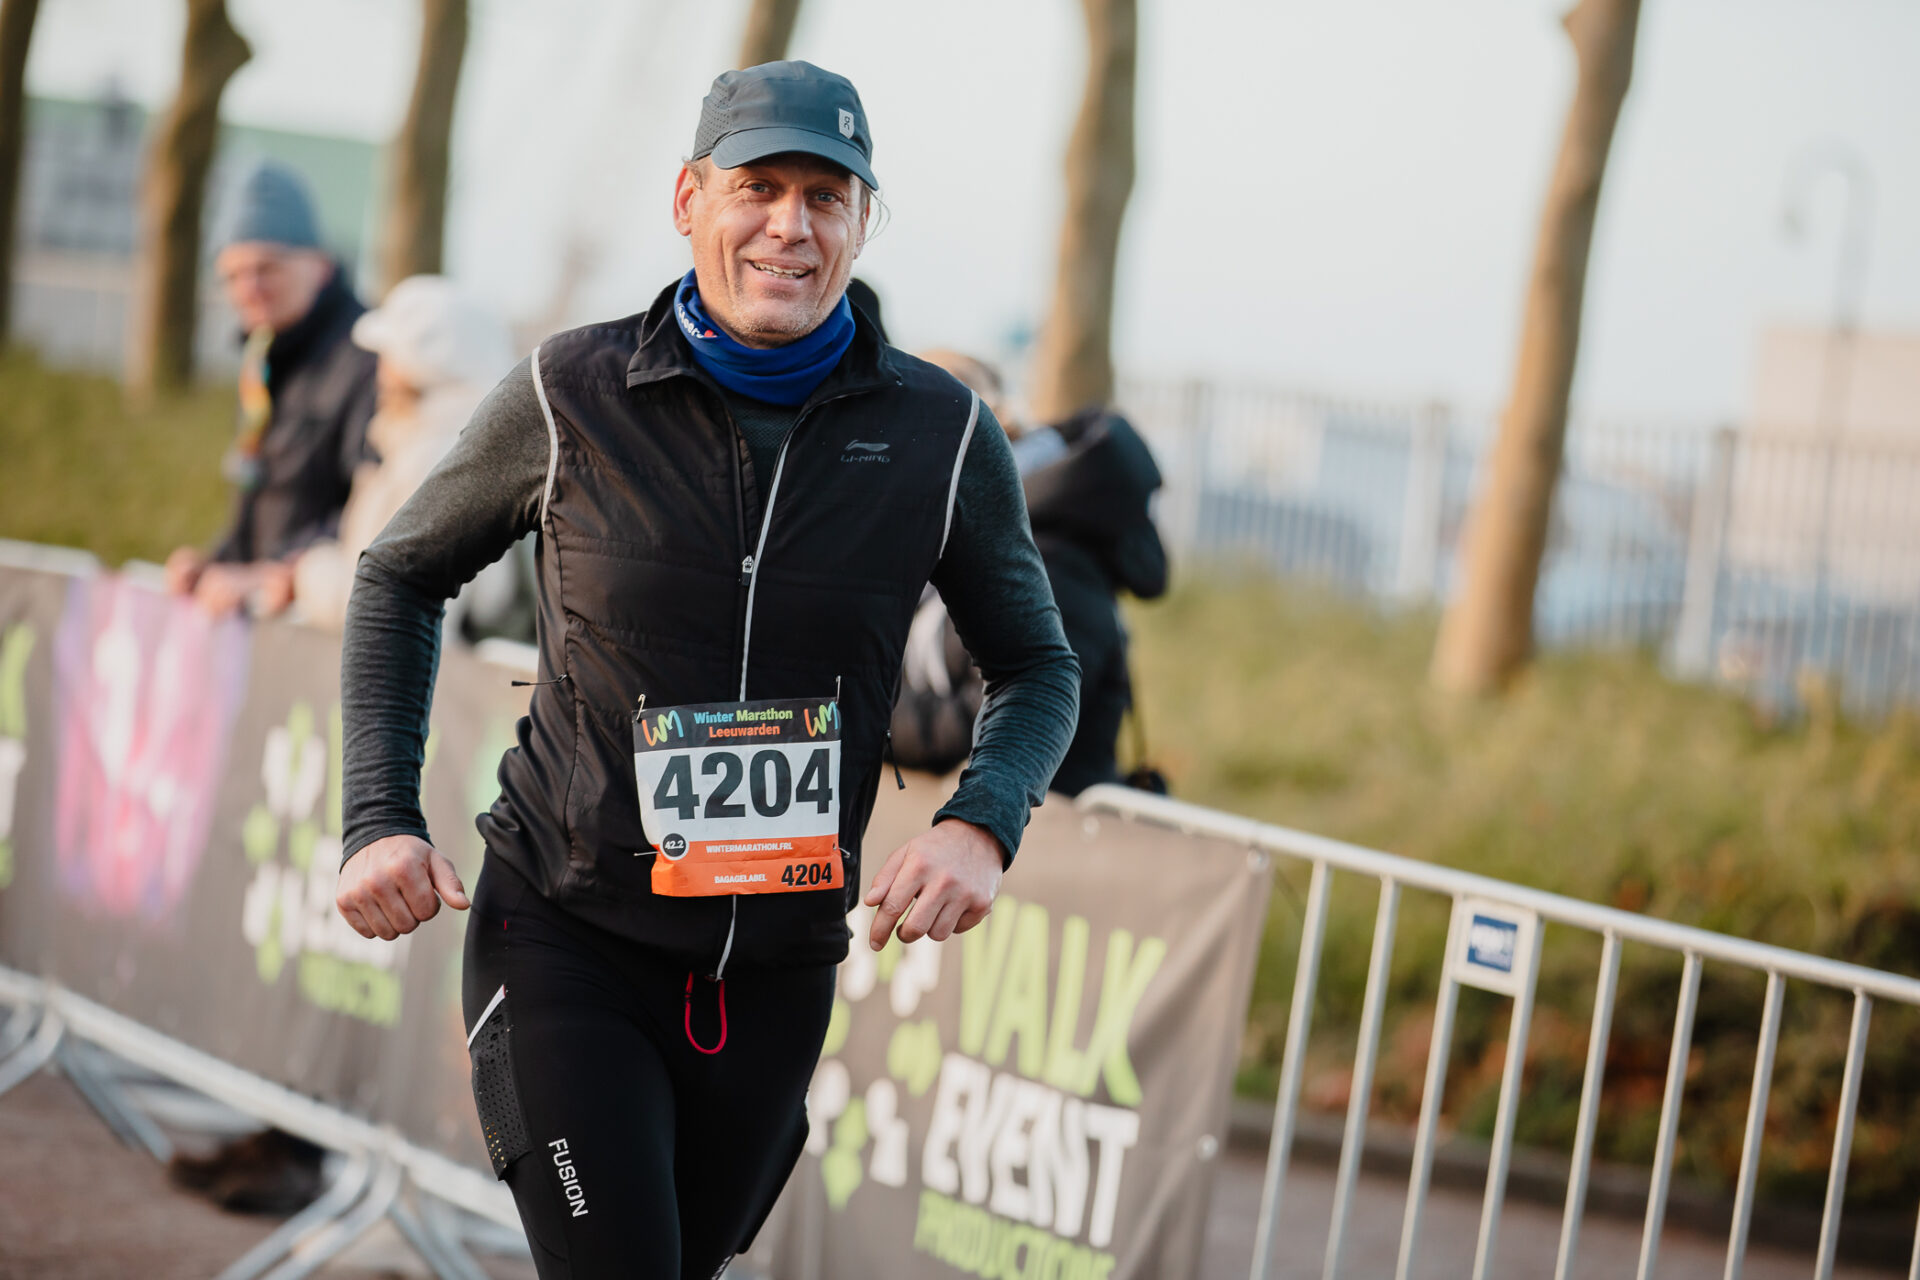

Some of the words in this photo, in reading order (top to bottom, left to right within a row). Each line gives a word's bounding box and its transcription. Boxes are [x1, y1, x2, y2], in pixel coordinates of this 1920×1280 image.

[693, 711, 734, 724] Winter
[736, 708, 793, 722] Marathon
[709, 724, 780, 738] Leeuwarden
[653, 748, 833, 820] 4204
[664, 839, 685, 850] 42.2
[706, 842, 793, 854] WINTERMARATHON.FRL
[714, 874, 768, 884] BAGAGELABEL
[781, 862, 833, 888] 4204
[958, 893, 1168, 1108] VALK
[921, 1051, 1140, 1248] EVENT
[548, 1137, 589, 1218] FUSION
